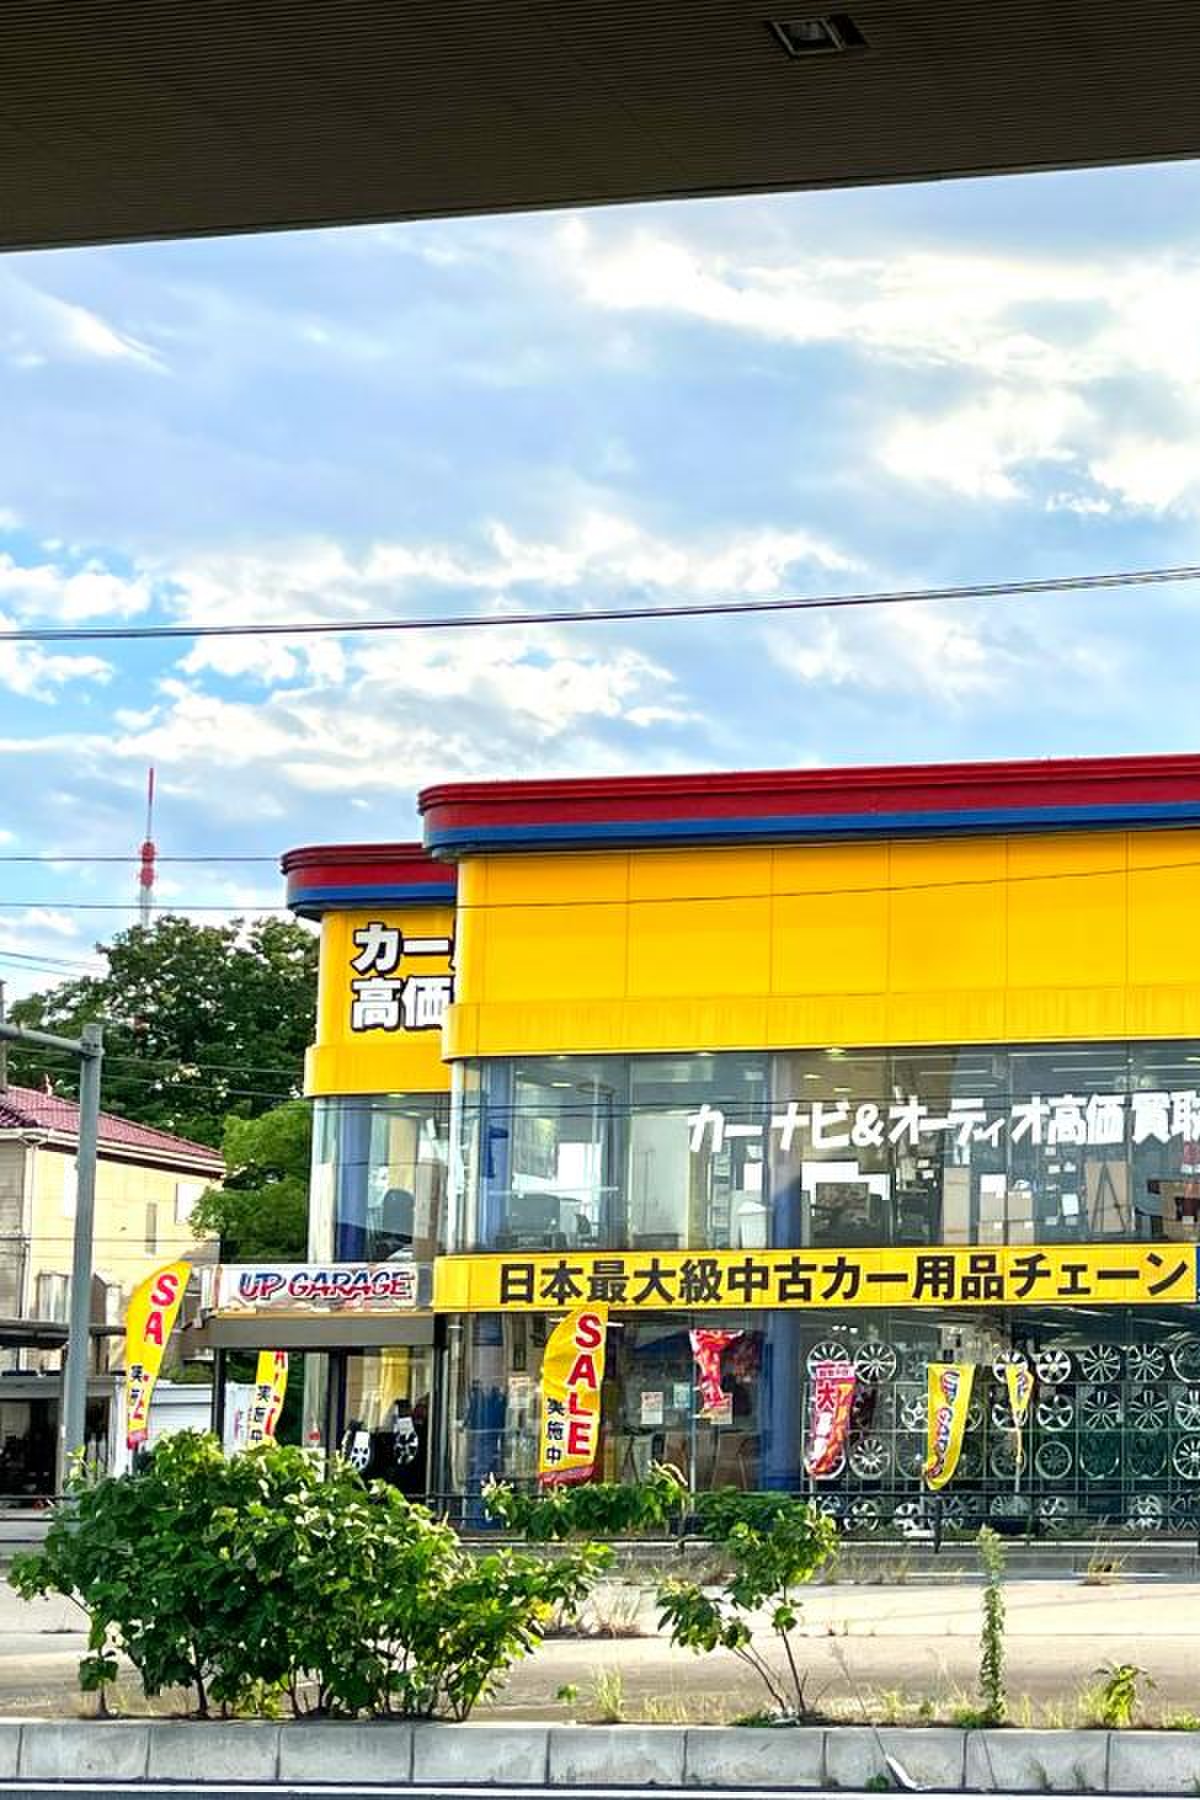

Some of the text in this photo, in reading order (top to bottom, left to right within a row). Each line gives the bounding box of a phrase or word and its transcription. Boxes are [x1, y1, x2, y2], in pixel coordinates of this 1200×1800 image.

[350, 921, 454, 976] カー
[239, 1270, 414, 1299] UP GARAGE
[499, 1253, 1189, 1305] 日本最大級中古カー用品チェーン
[567, 1313, 602, 1457] SALE
[545, 1397, 566, 1464] 実施中
